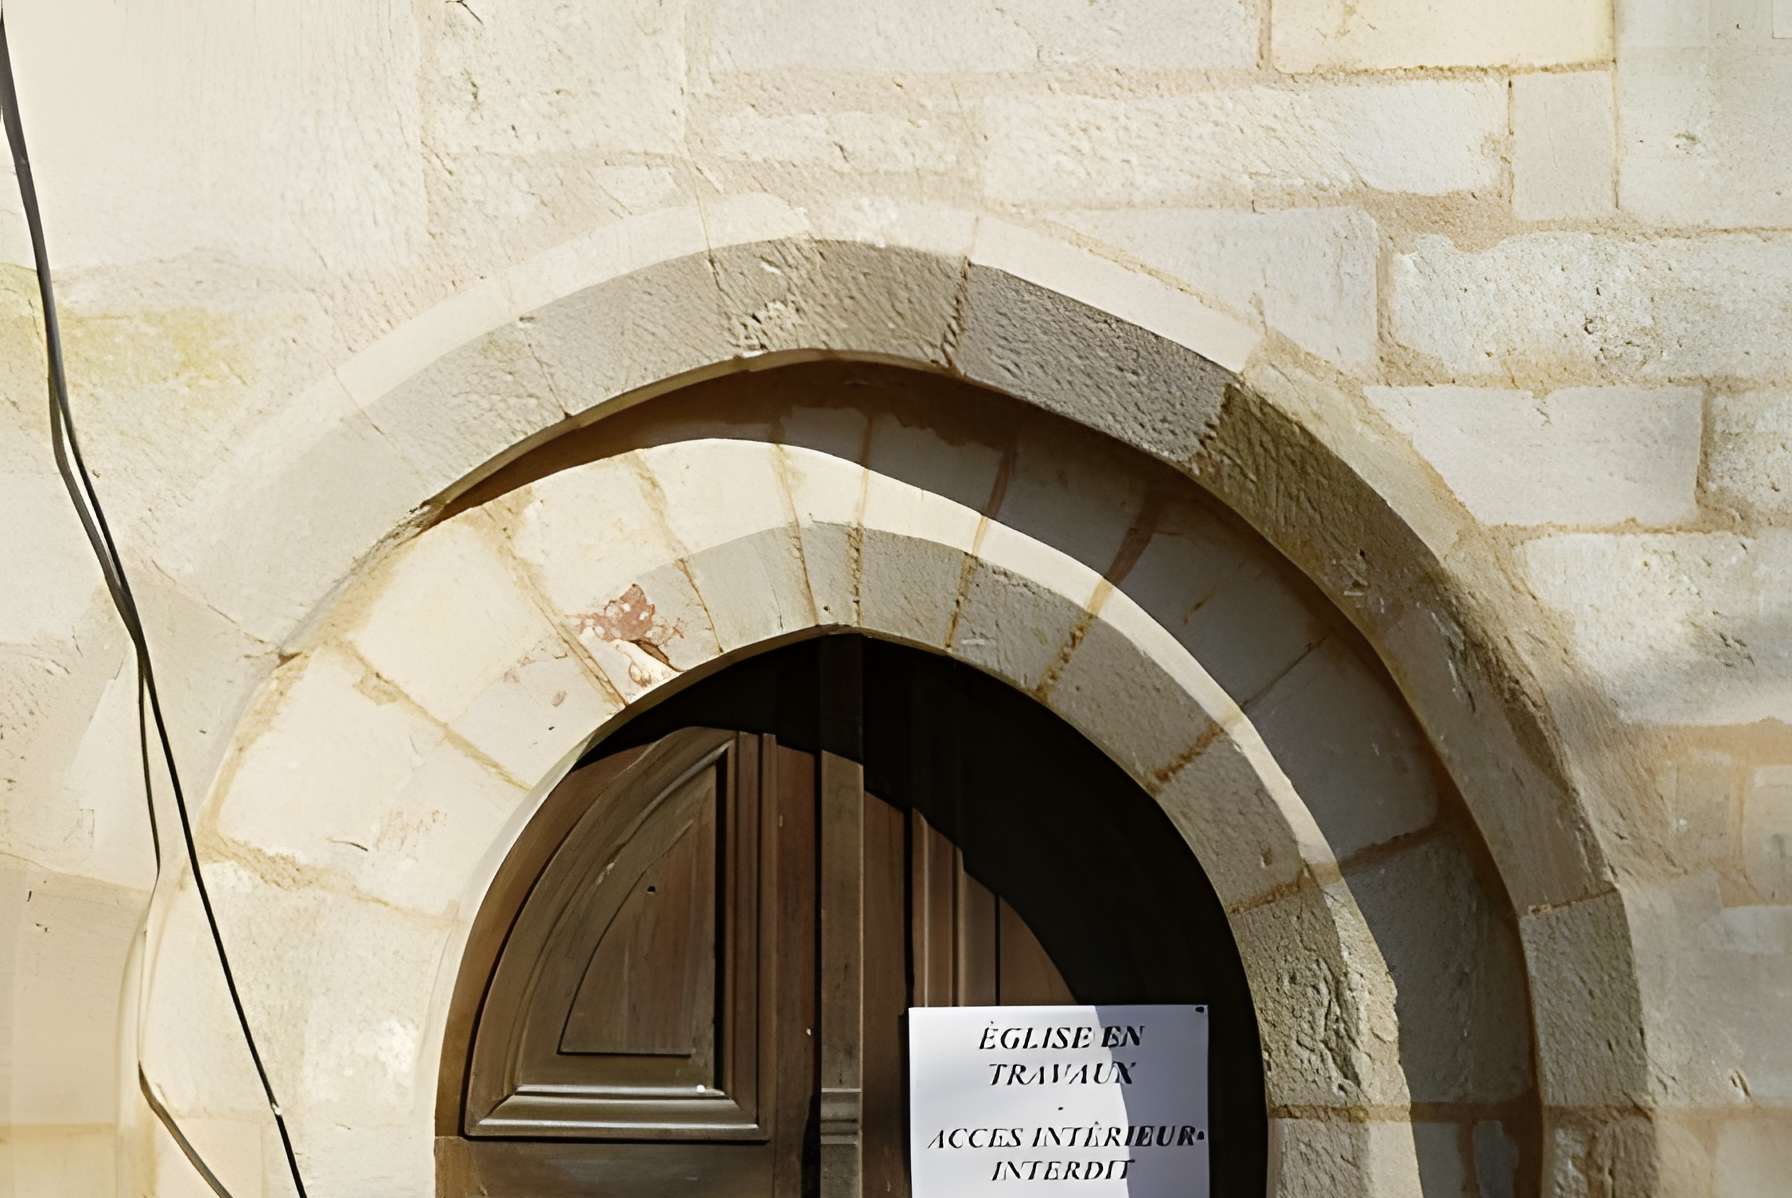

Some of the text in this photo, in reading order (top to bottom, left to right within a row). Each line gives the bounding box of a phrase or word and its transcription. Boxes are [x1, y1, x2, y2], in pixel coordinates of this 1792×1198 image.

[1101, 1025, 1145, 1049] EN
[989, 1062, 1137, 1086] TRAVAUX
[992, 1159, 1136, 1181] INTERDIT
